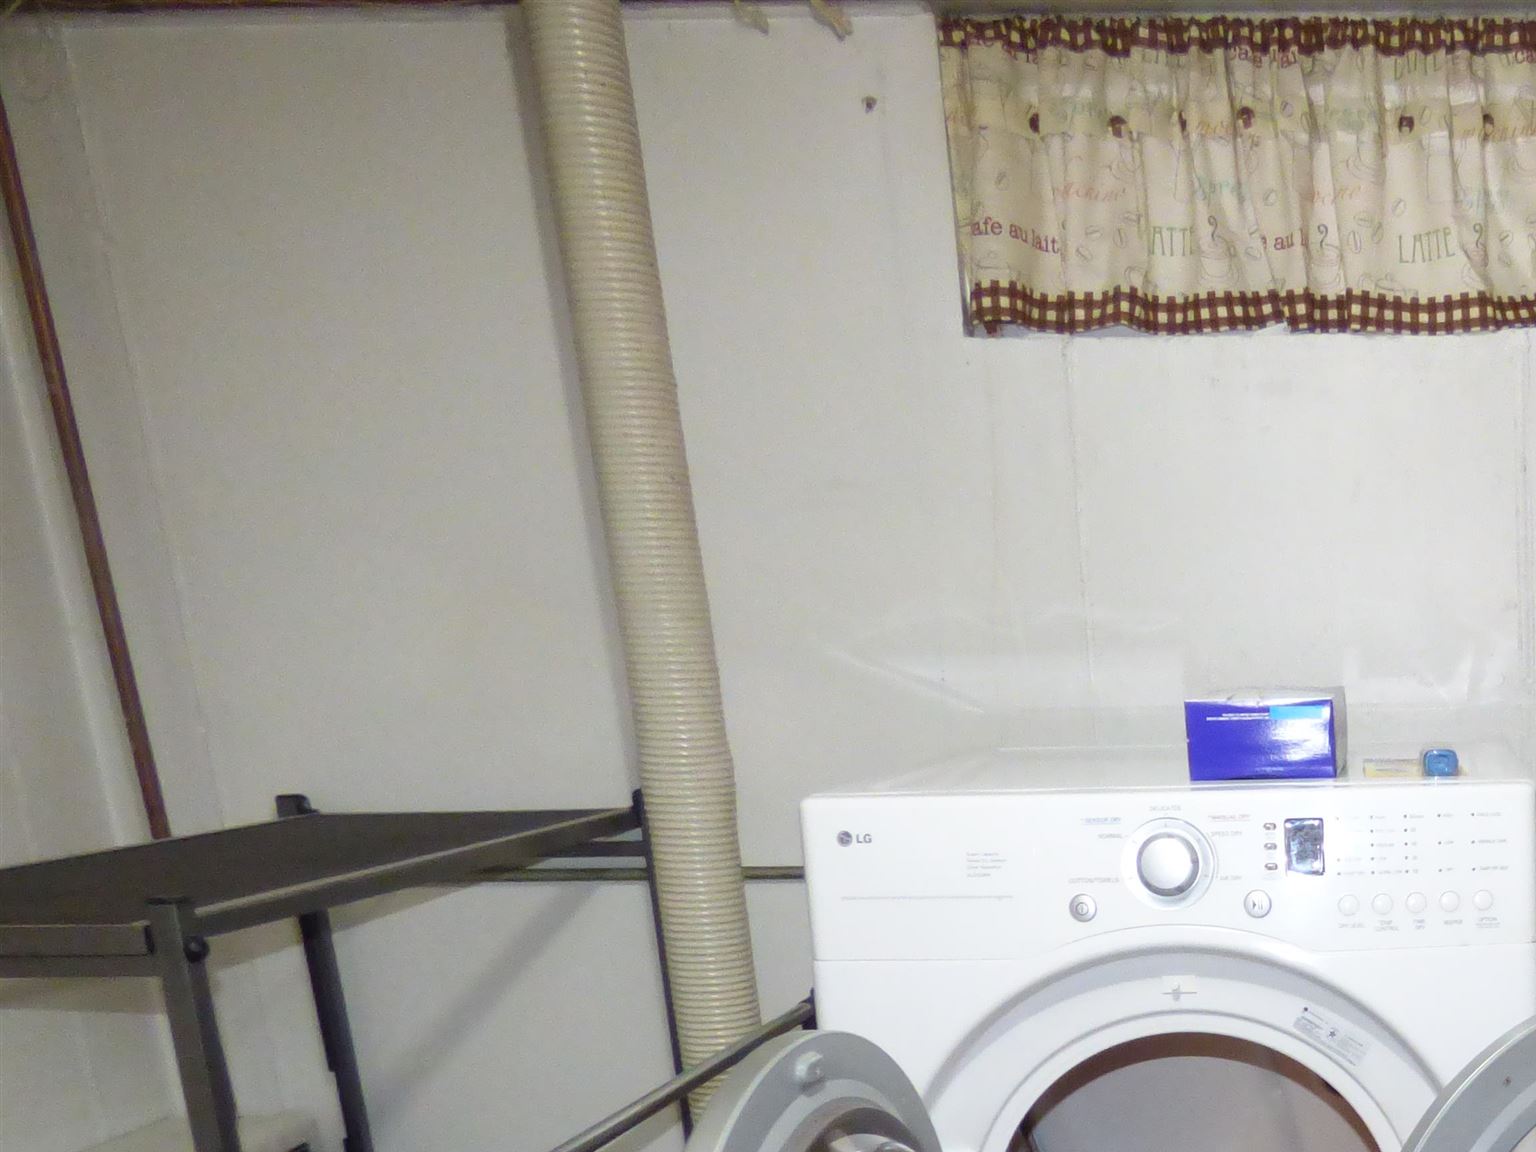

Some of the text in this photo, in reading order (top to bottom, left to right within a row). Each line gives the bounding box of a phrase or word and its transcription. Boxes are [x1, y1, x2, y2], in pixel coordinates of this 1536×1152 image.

[1009, 223, 1028, 244] au
[1031, 228, 1060, 254] lait
[1398, 226, 1456, 264] LATTE
[856, 833, 872, 844] LG
